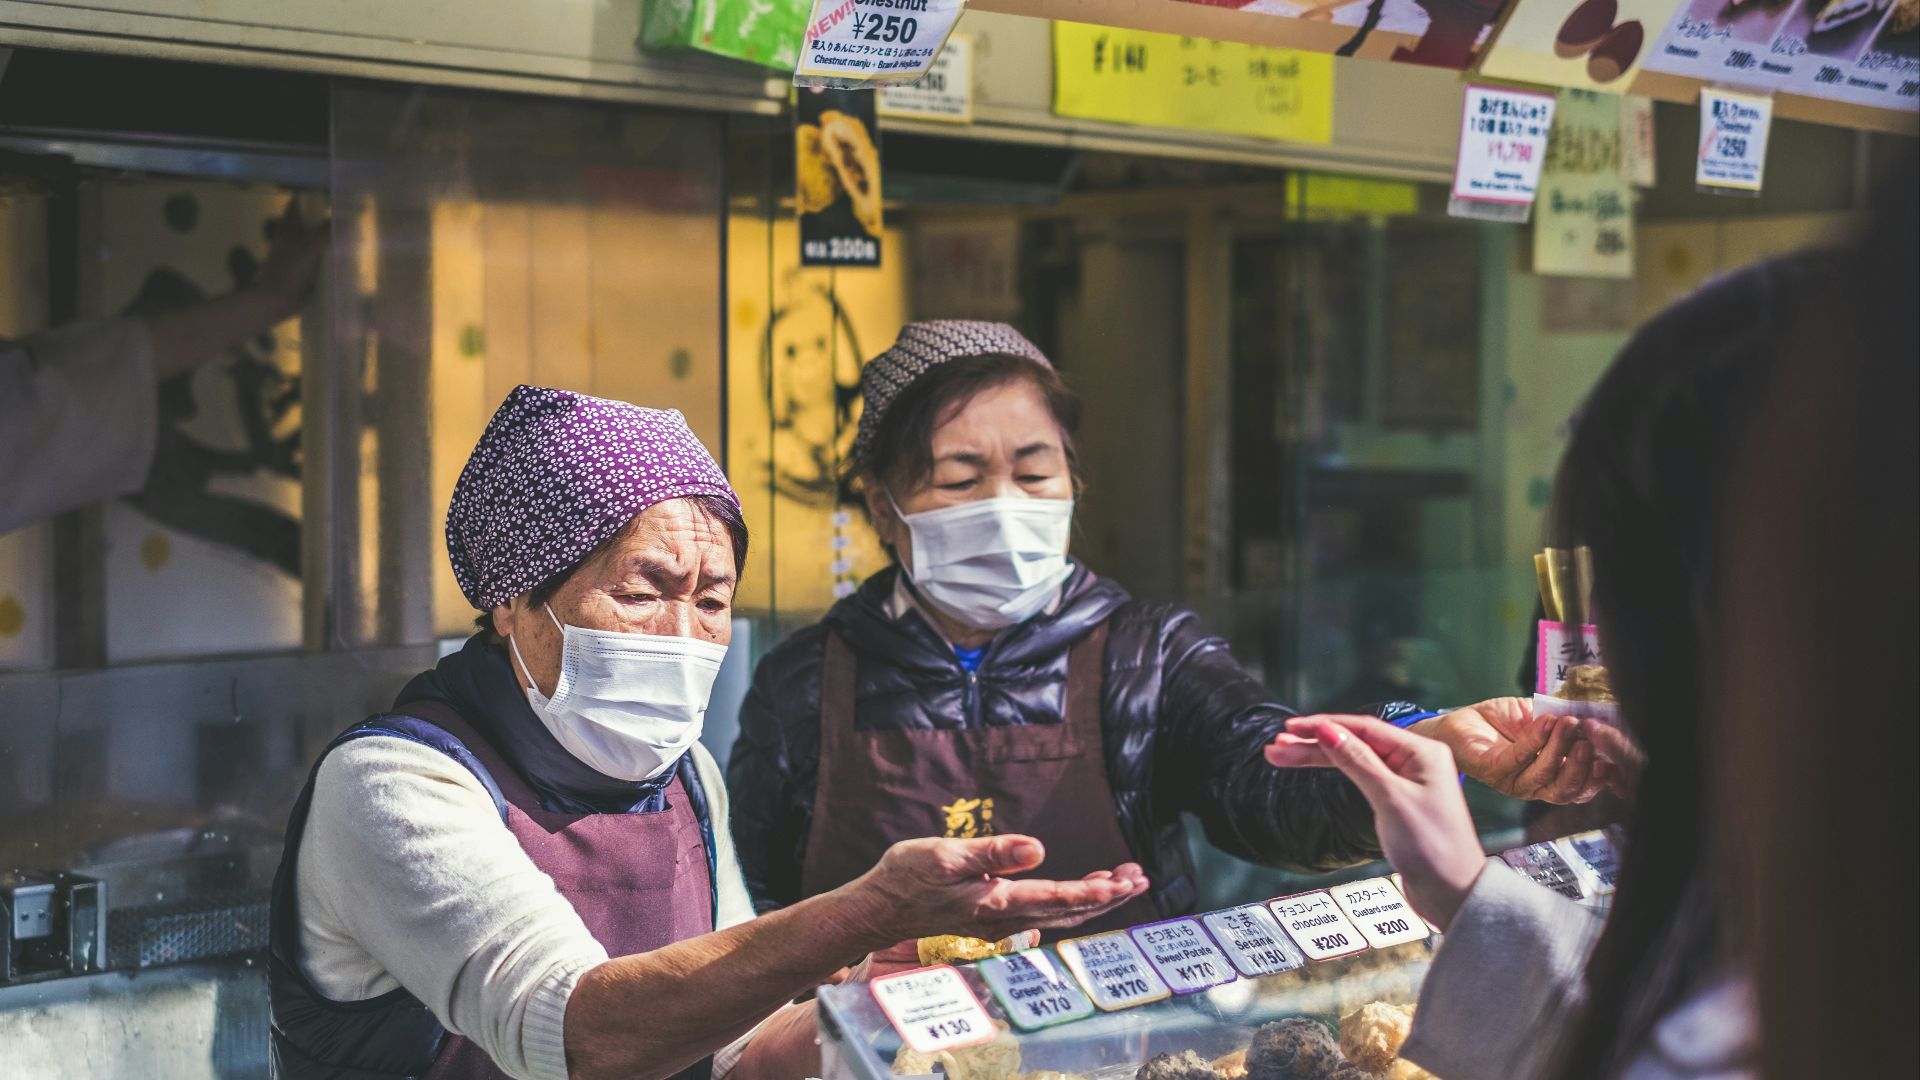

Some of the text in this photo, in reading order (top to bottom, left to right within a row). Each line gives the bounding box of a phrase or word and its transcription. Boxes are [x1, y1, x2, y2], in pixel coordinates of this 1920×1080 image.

[806, 0, 857, 45] NEW!!
[852, 11, 918, 44] ¥250
[814, 54, 848, 66] Chestnut
[847, 58, 872, 70] manju
[1345, 886, 1387, 905] カスタード
[1277, 897, 1330, 918] チョコレート
[1352, 902, 1404, 918] Custard cream
[1223, 912, 1256, 930] ごま
[1291, 913, 1339, 931] chocolate
[1373, 918, 1410, 936] ¥200
[1143, 923, 1195, 944] さつまいも
[1234, 935, 1275, 951] Sesame
[1311, 932, 1350, 951] ¥200
[1155, 951, 1185, 965] Sweet
[1246, 949, 1287, 968] ¥150
[1175, 961, 1216, 981] ¥170
[1008, 984, 1046, 1000] Green
[1106, 978, 1149, 998] ¥170
[1026, 996, 1072, 1017] ¥170
[926, 1018, 972, 1039] ¥130
